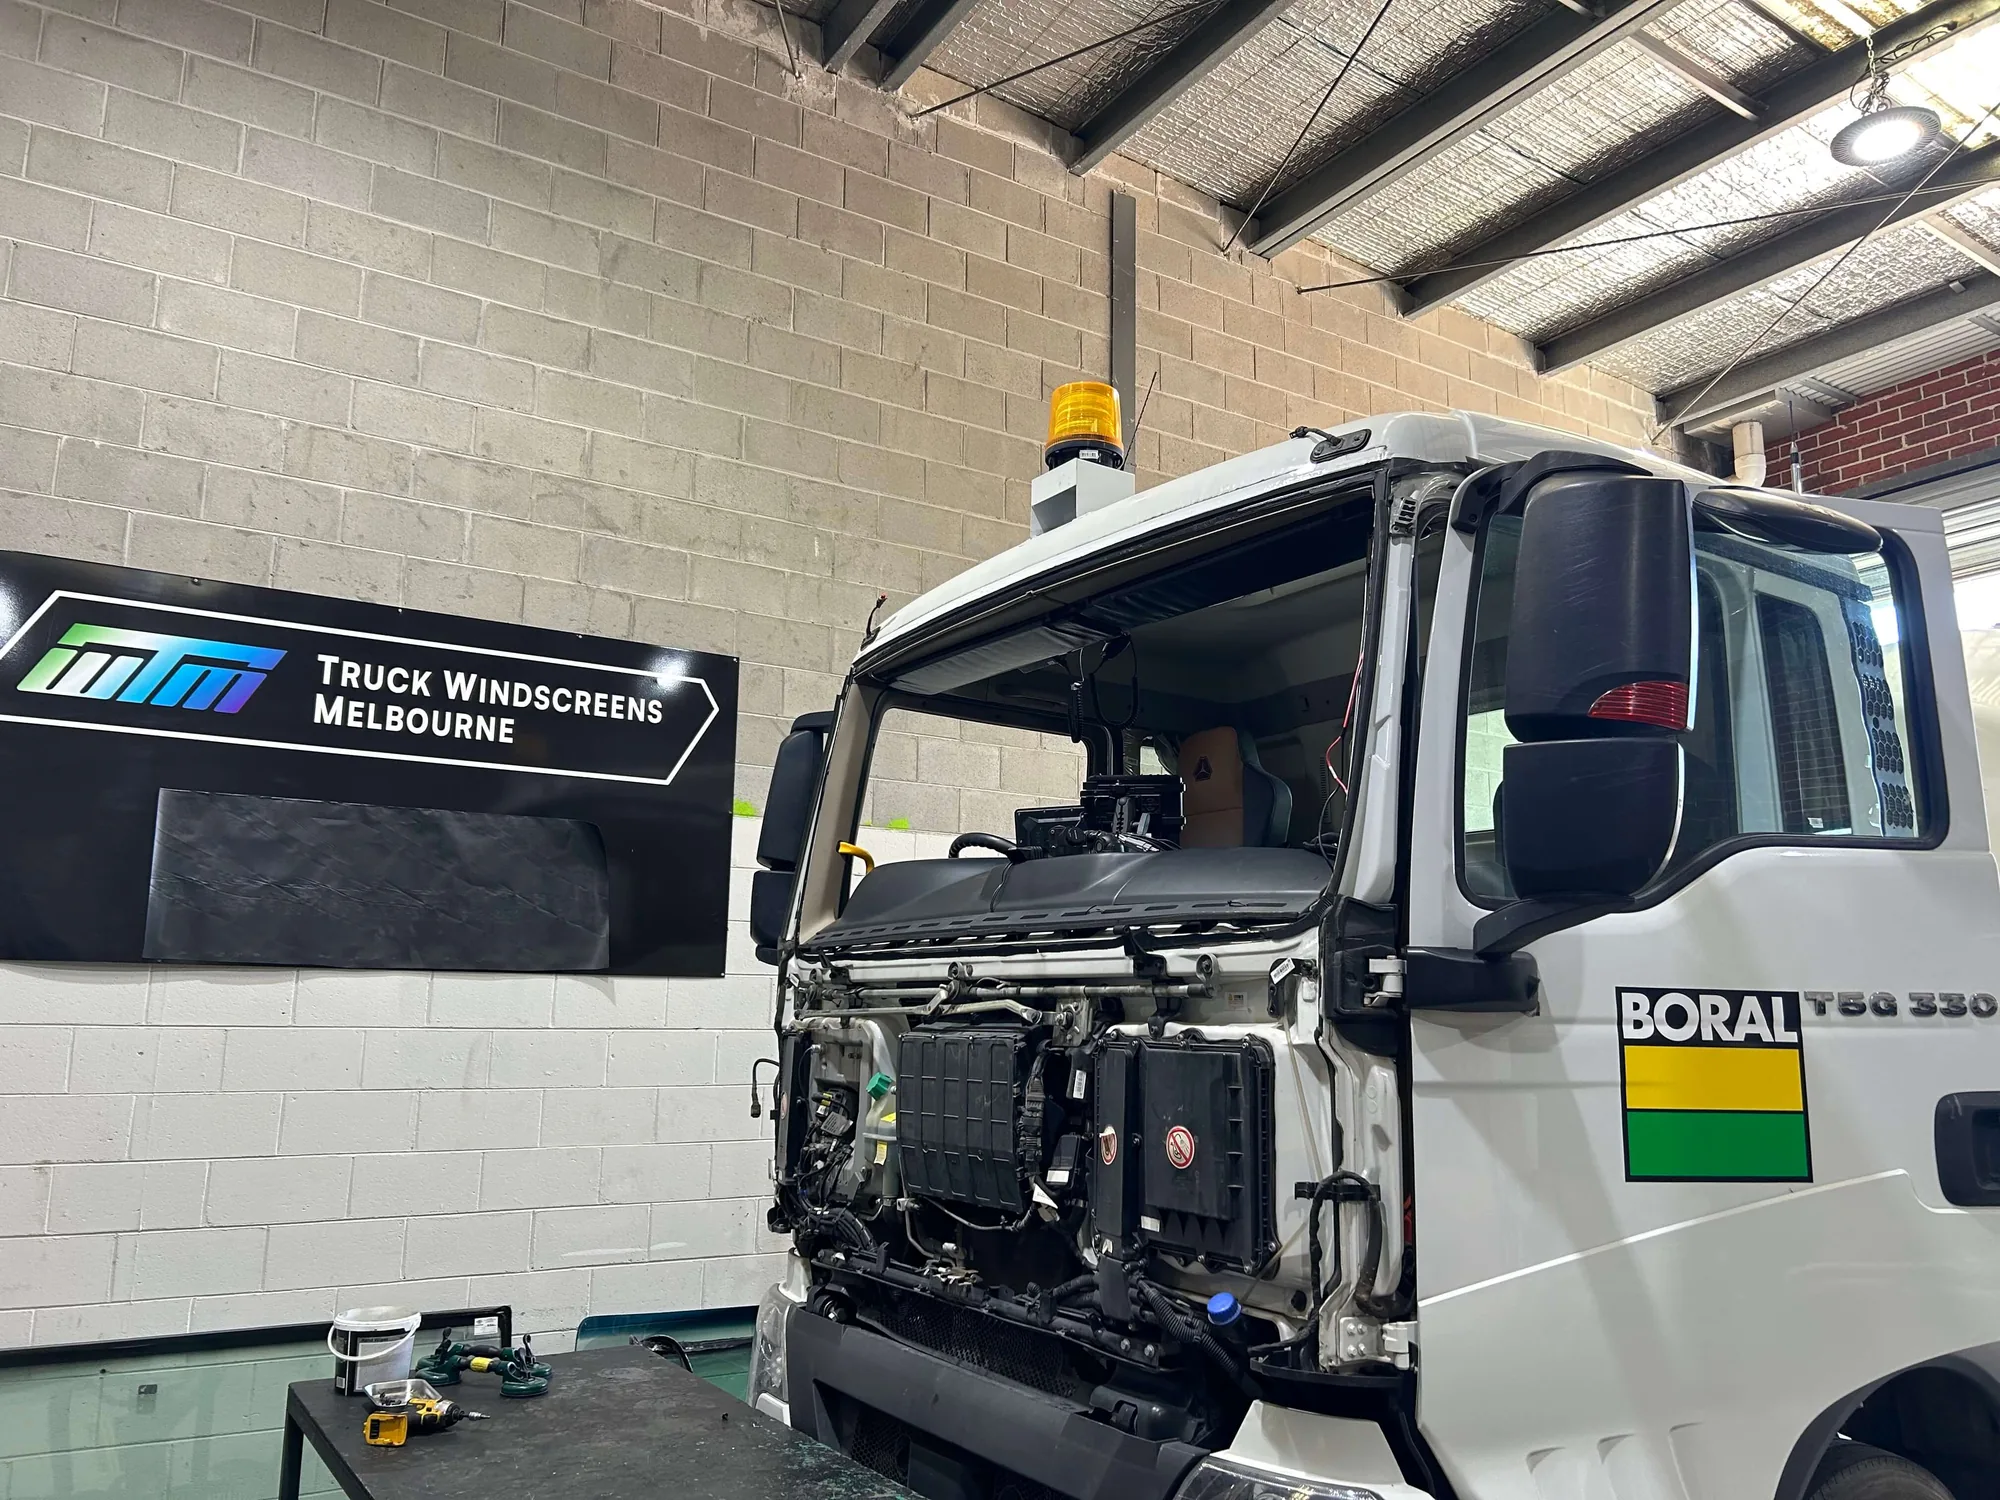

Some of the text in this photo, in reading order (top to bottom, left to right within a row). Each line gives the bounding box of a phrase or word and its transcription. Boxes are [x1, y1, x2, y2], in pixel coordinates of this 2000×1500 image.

[317, 654, 663, 723] TRUCK WINDSCREENS
[313, 694, 515, 743] MELBOURNE
[1622, 992, 1797, 1043] BORAL
[1909, 992, 1998, 1018] 330
